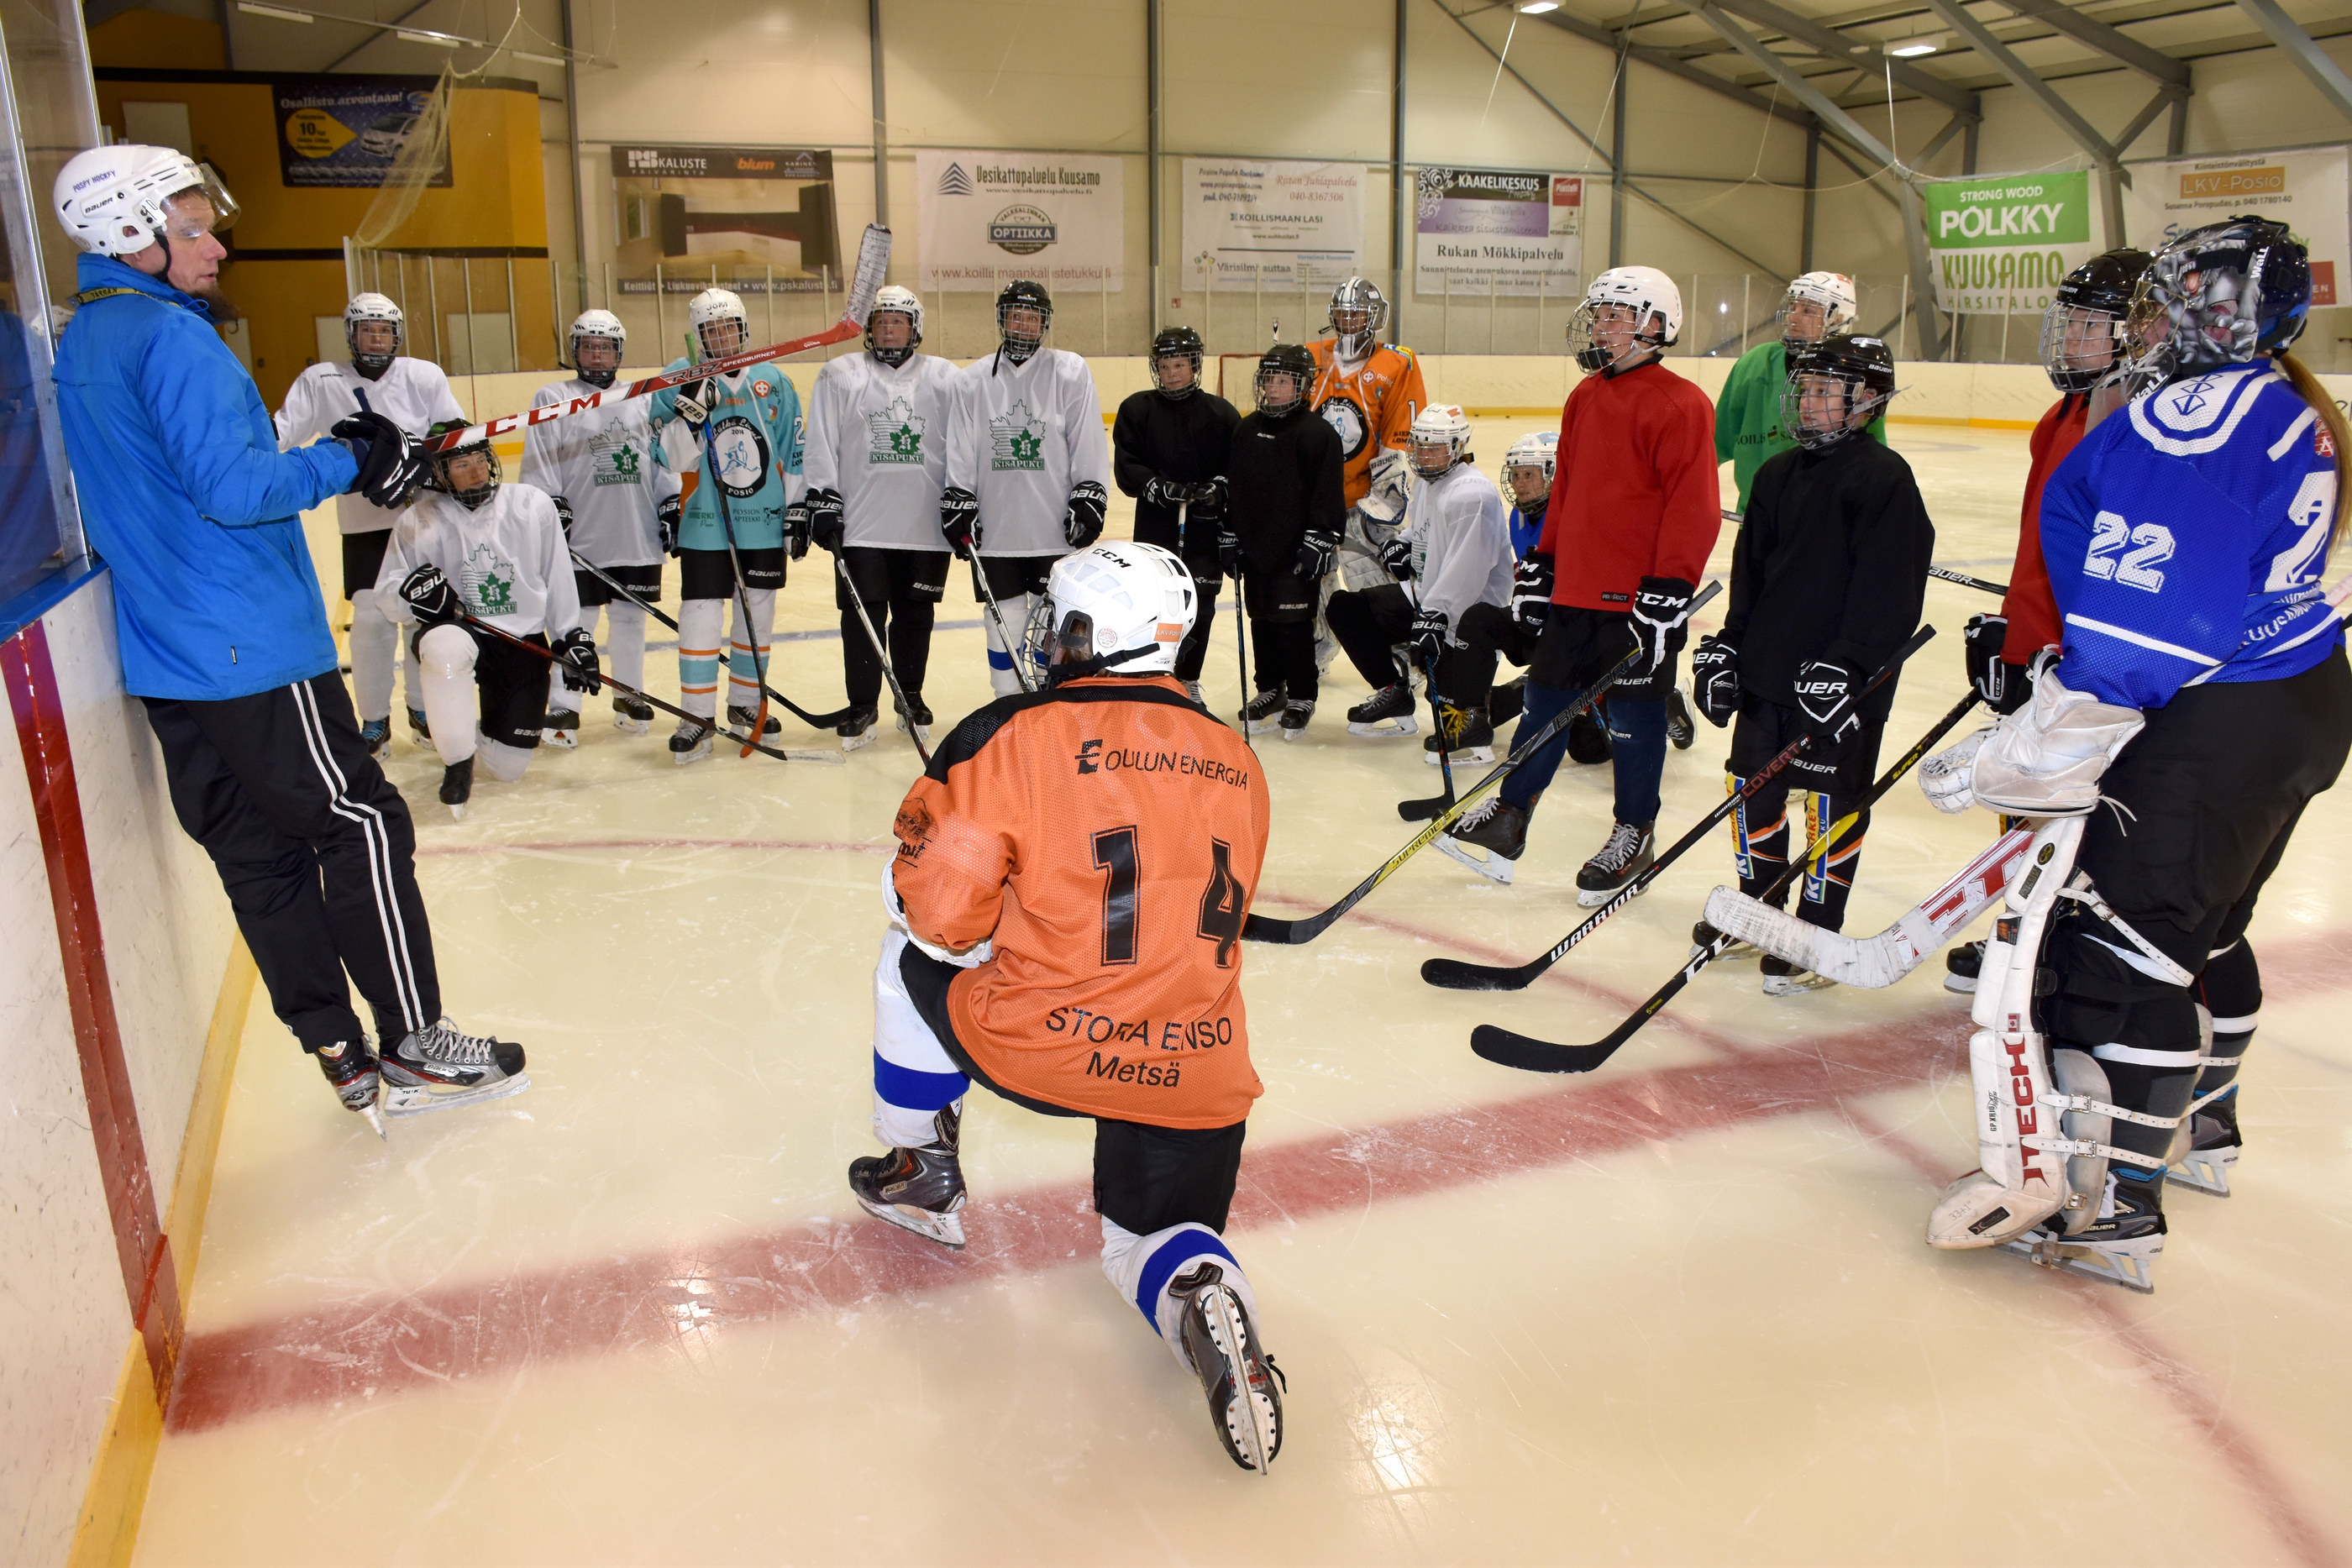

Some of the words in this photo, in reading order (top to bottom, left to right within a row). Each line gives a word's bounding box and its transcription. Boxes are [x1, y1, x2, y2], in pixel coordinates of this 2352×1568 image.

[281, 97, 335, 108] Osallistu
[338, 92, 403, 105] arvontaan!
[299, 123, 317, 135] 10
[737, 157, 775, 170] blum
[976, 165, 1056, 186] Vesikattopalvelu
[1058, 167, 1100, 186] Kuusamo
[1305, 176, 1357, 189] Juhlapalvelu
[1458, 173, 1540, 191] KAAKELIKESKUS
[72, 176, 92, 193] POSPY
[985, 186, 1092, 196] www.vesikattopalvelu.fi
[1289, 191, 1344, 202] 040-8367506
[1960, 188, 2003, 202] STRONG
[2006, 186, 2044, 199] WOOD
[85, 197, 113, 213] BAUER
[2165, 202, 2192, 211] Susanna
[2243, 197, 2258, 206] 040
[2260, 195, 2292, 204] 1780140
[1239, 212, 1301, 223] KOILLISMAAN
[1303, 214, 1323, 223] LASI
[993, 227, 1052, 239] OPTIIKKA
[1437, 244, 1478, 258] Rukan
[1483, 245, 1564, 262] Mökkipalvelu
[932, 266, 1111, 281] www.koillismaankalustetukkufi
[1263, 264, 1291, 273] auttaa
[1941, 250, 2065, 290] KUUSAMO
[752, 281, 838, 292] www.pskalust.fi
[1947, 295, 2058, 310] HRSITALO
[660, 361, 723, 385] RBZ
[722, 350, 776, 368] SPEEDBURNER
[485, 391, 601, 438] CCM
[871, 454, 923, 463] KISAPUKU
[993, 459, 1044, 469] KISAPUKU
[1370, 453, 1399, 469] BAUER
[727, 487, 754, 496] POSIO
[1070, 489, 1107, 504] BAUE
[1304, 533, 1334, 549] AUER
[1091, 548, 1132, 569] CCM
[2082, 510, 2177, 594] 22
[748, 569, 781, 578] BAUER
[1929, 566, 1973, 585] AUER
[1613, 675, 1654, 687] AUER
[1555, 659, 1628, 732] BAUER
[1609, 726, 1632, 739] AUER
[1105, 746, 1176, 774] OULUN
[1180, 754, 1249, 792] ENERGIA
[1740, 742, 1800, 798] COVERT
[1788, 758, 1838, 775] AUER
[1893, 753, 1919, 780] SUPER
[1714, 793, 1741, 819] WARRIOR
[1390, 821, 1443, 870] SUPREME
[1090, 824, 1247, 969] 14
[1551, 884, 1639, 963] WARRIOR
[1161, 1016, 1232, 1051] ENSO
[1086, 1051, 1180, 1088] Metsä
